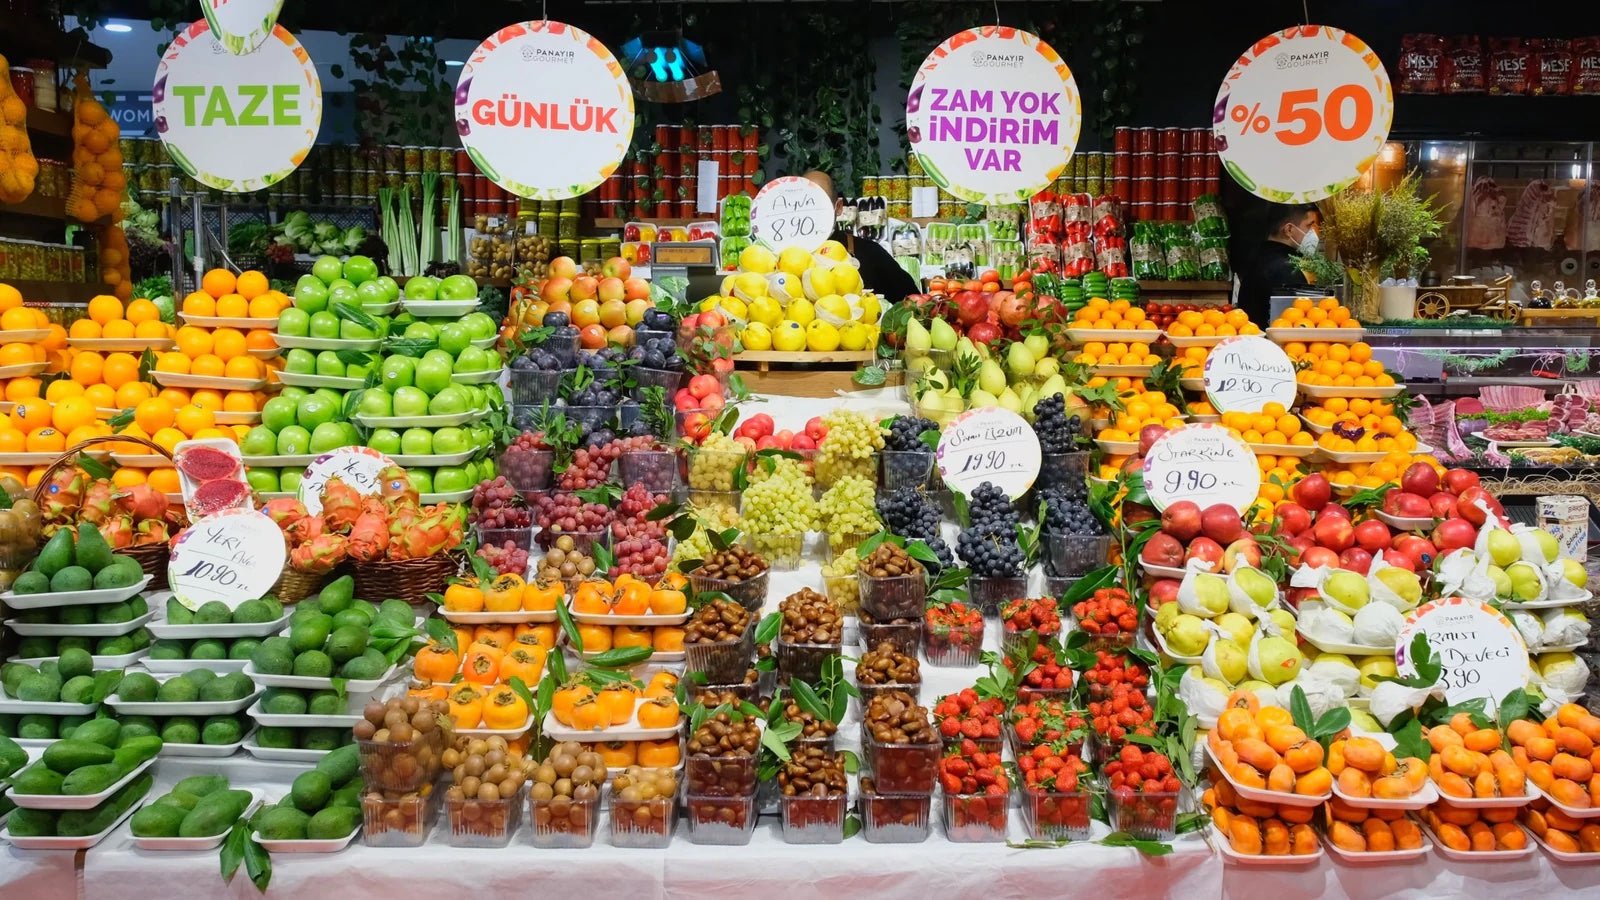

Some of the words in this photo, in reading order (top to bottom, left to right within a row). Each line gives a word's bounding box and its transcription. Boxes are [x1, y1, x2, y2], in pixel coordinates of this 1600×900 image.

[537, 49, 575, 58] PANAYIR
[1290, 51, 1329, 61] PANAYIR
[173, 84, 302, 127] TAZE
[471, 94, 618, 134] GÜNLÜK
[930, 88, 993, 113] ZAM
[1001, 91, 1060, 115] YOK
[964, 148, 1022, 172] VAR
